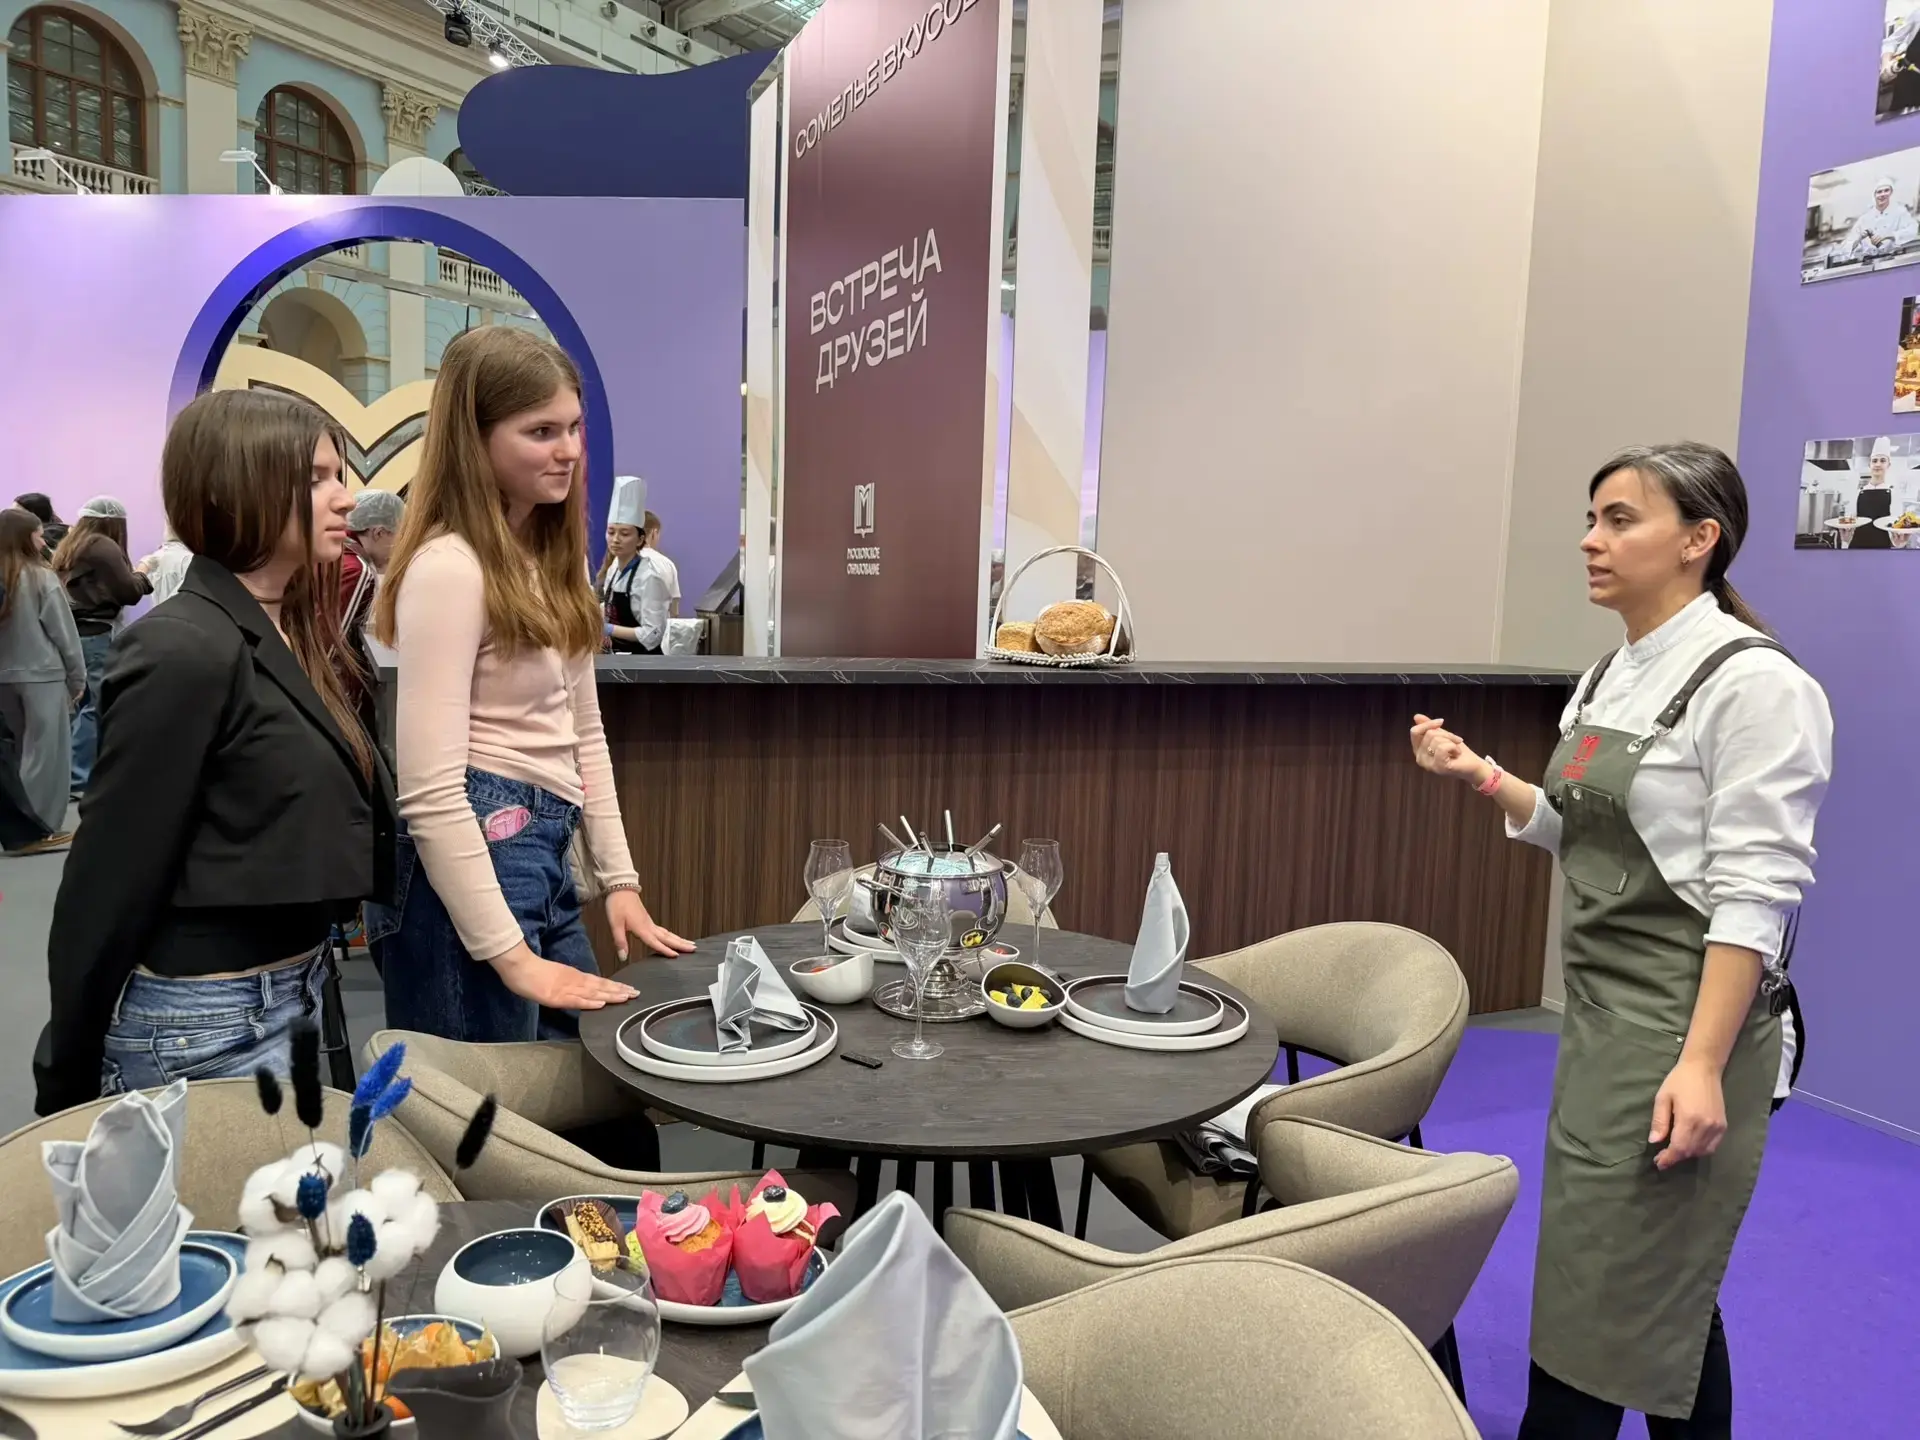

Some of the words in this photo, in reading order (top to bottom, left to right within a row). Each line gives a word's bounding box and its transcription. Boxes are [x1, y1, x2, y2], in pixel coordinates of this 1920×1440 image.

[796, 59, 879, 159] СОМЕЛЬЕ
[882, 0, 979, 83] ВКУСО
[811, 228, 942, 335] ВСТРЕЧА
[816, 288, 928, 394] ДРУЗЕЙ
